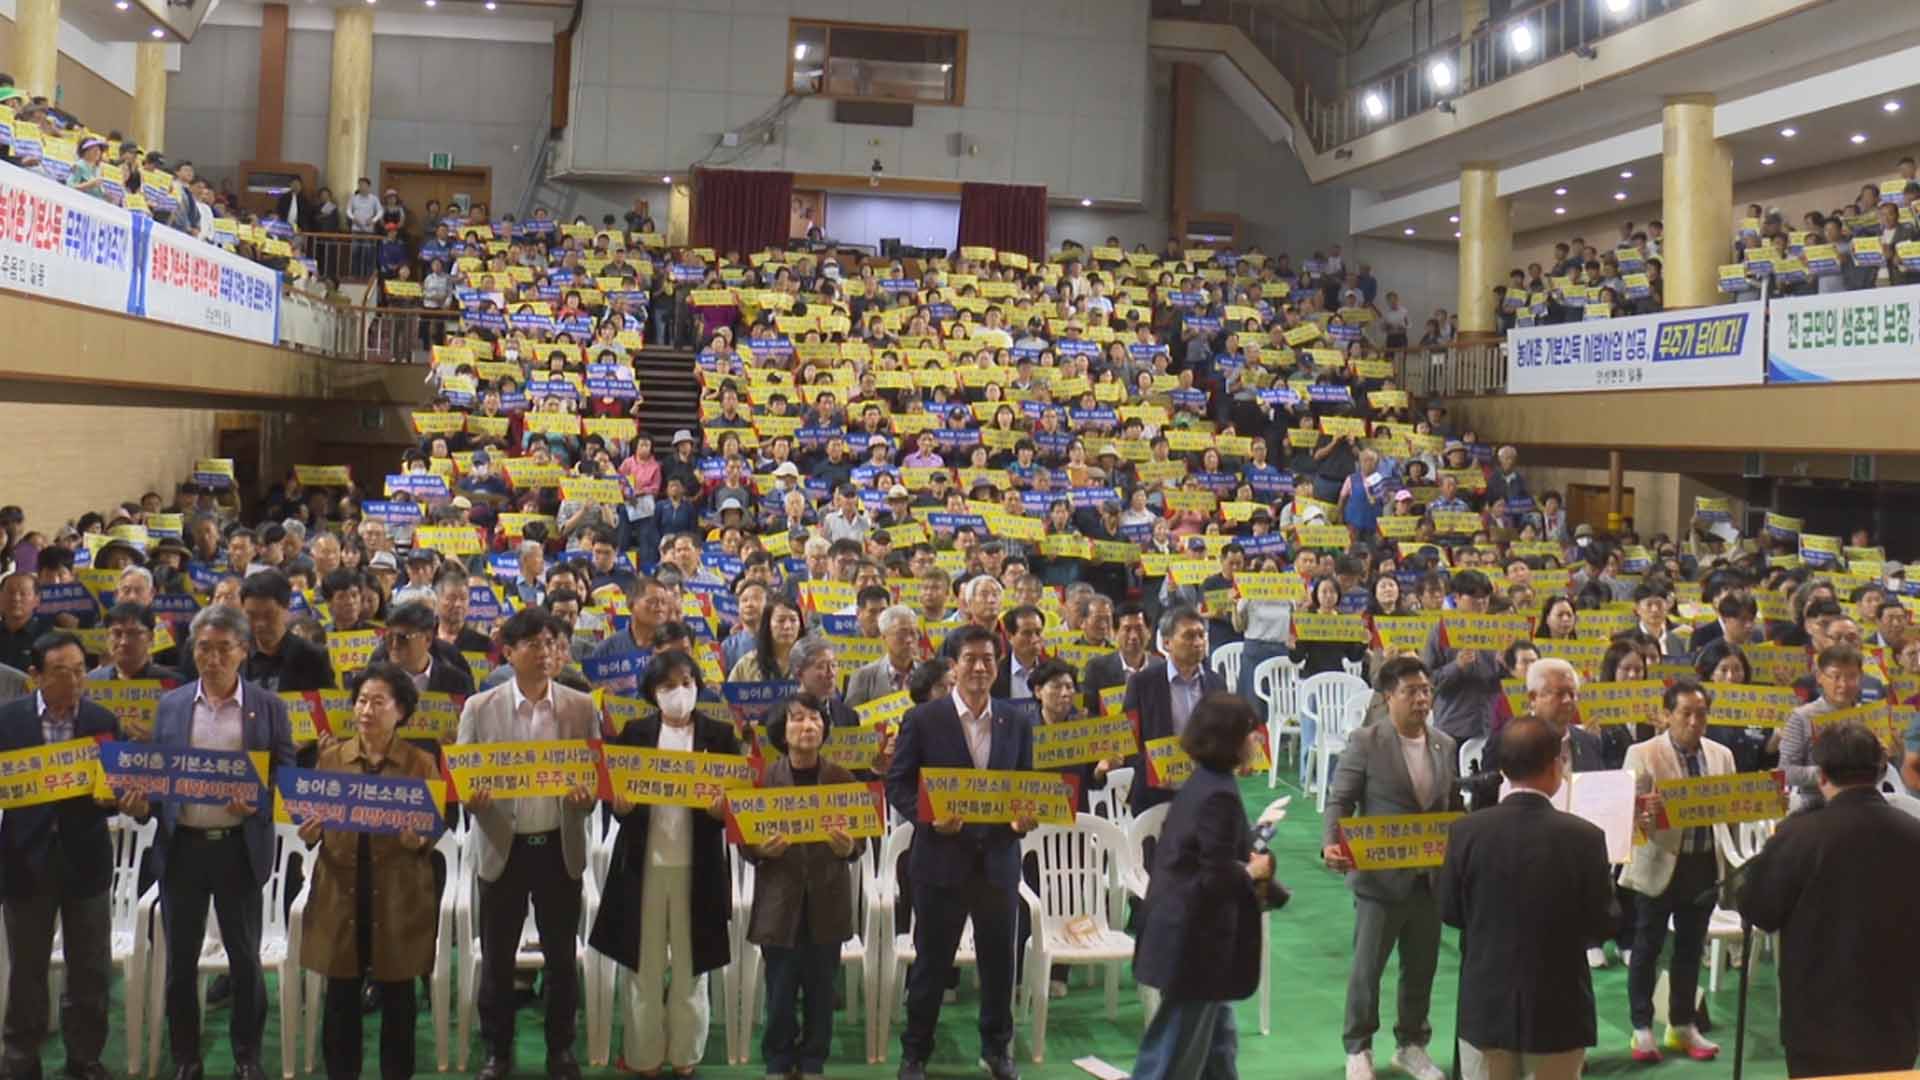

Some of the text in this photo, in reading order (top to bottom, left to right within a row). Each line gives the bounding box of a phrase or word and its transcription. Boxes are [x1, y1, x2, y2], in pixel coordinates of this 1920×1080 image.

[1787, 301, 1914, 350] 전 군민의 생존권 보장,
[1516, 338, 1544, 368] 농어촌
[1545, 333, 1582, 367] 기본소득
[1583, 330, 1623, 365] 시범사업
[1625, 327, 1650, 362] 성공,
[1658, 323, 1696, 359] 무주가
[117, 751, 248, 776] 농어촌 기본소득은
[447, 754, 482, 769] 농어촌
[487, 750, 537, 766] 기본소득
[606, 752, 642, 771] 농어촌
[647, 756, 697, 775] 기본소득
[295, 776, 426, 806] 농어촌 기본소득은
[469, 774, 531, 791] 자연특별시
[626, 778, 689, 798] 자연특별시
[925, 776, 961, 793] 농어촌
[966, 776, 1013, 793] 기본소득
[730, 796, 768, 813] 농어촌
[773, 793, 821, 811] 기본소득
[753, 818, 816, 836] 자연특별시
